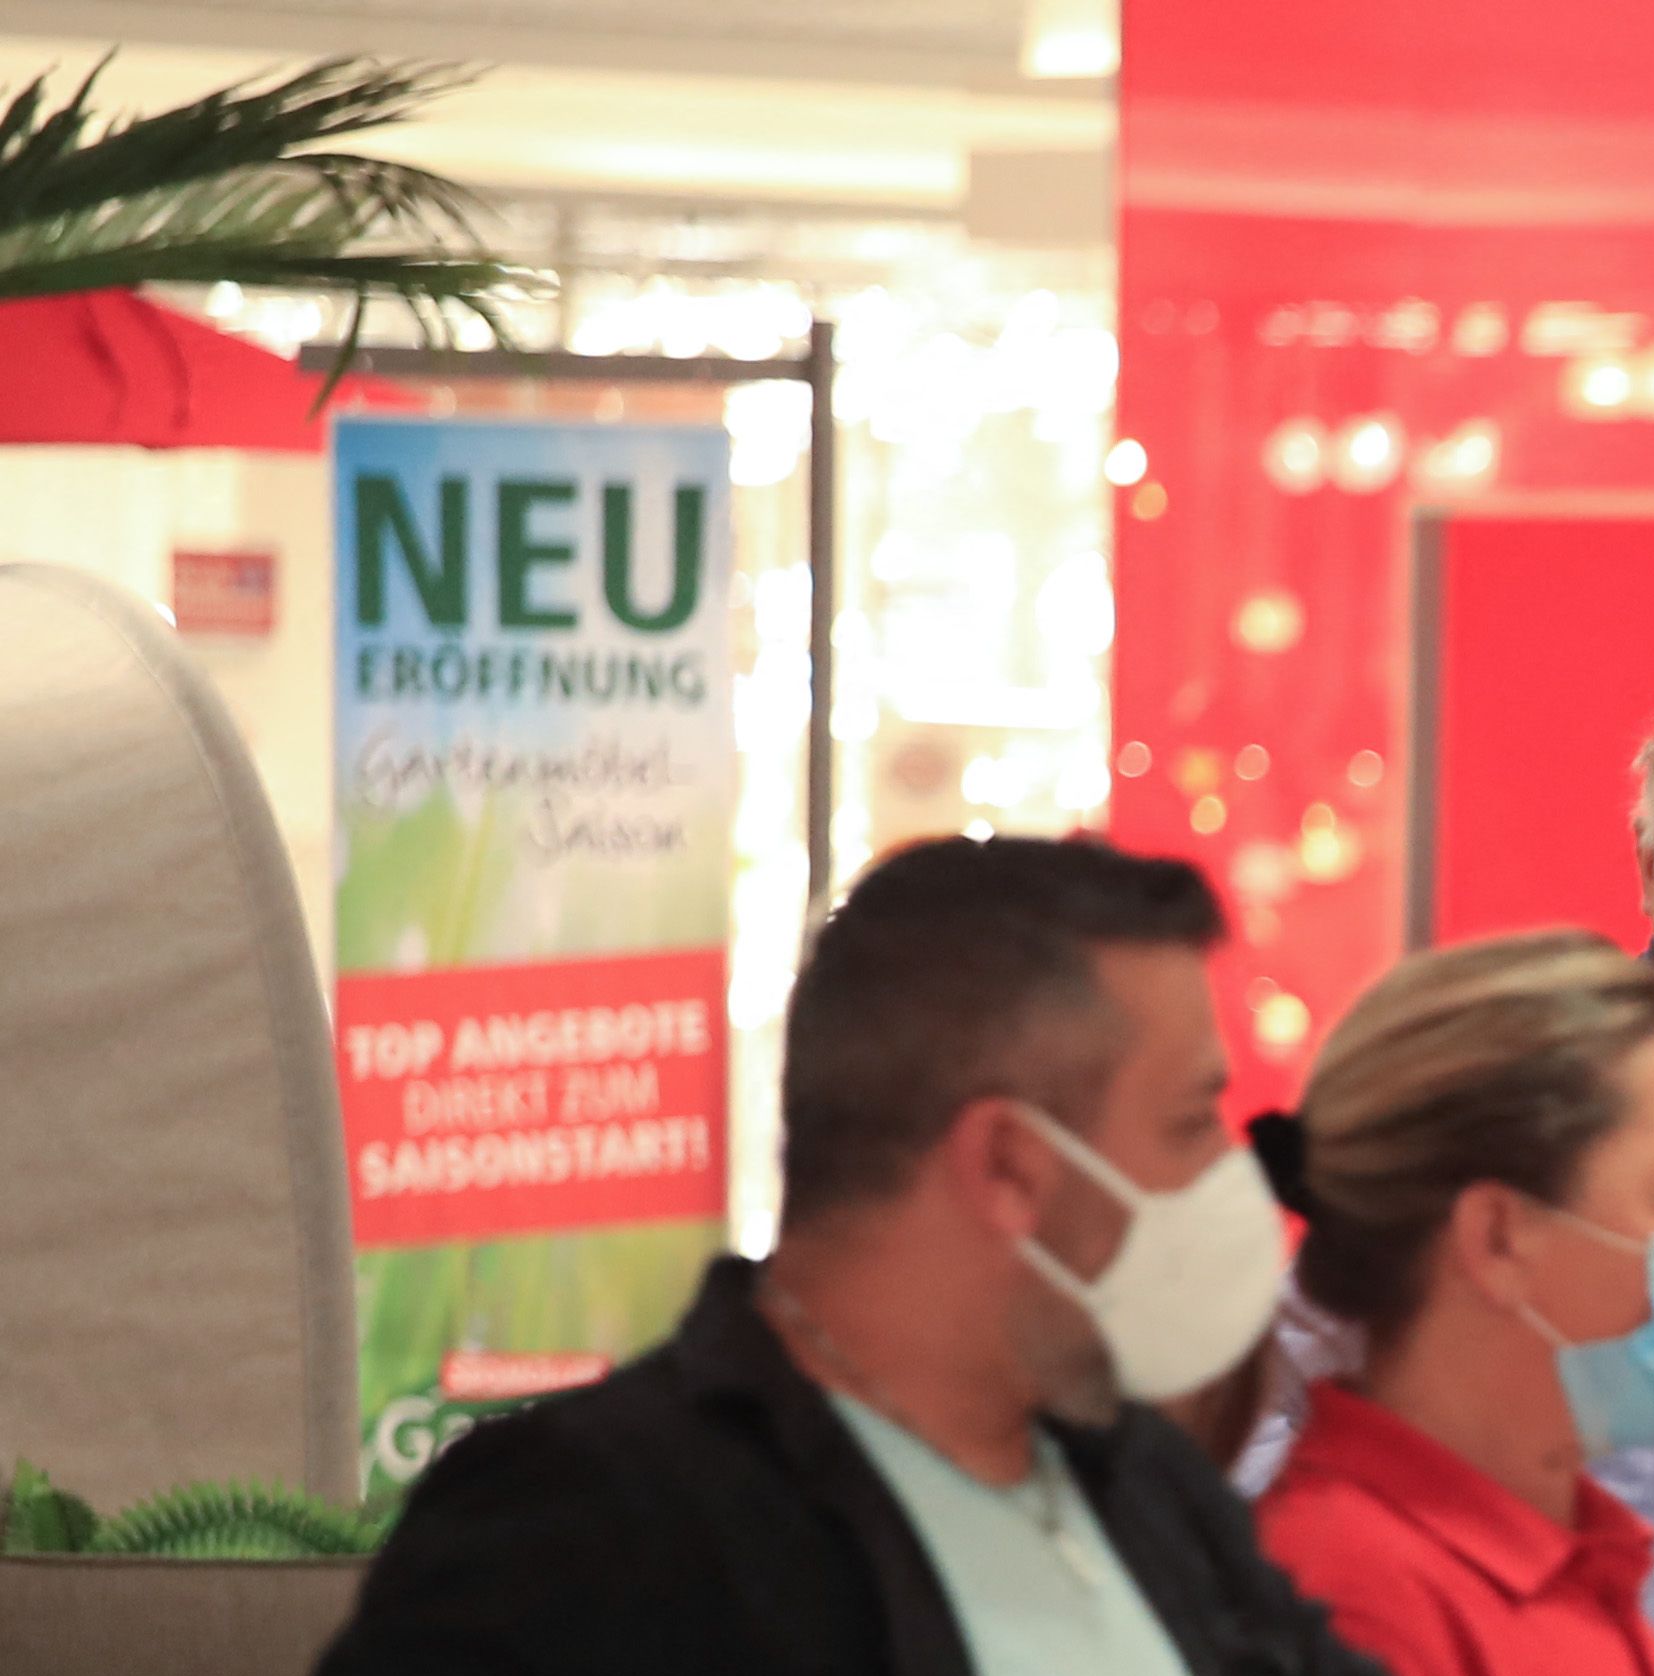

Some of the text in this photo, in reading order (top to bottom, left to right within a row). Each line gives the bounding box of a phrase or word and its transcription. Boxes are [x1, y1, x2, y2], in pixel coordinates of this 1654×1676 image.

[355, 473, 706, 634] NEU
[356, 638, 706, 703] ERÖFFNUNG
[347, 1000, 710, 1081] TOP ANGEBOTE
[404, 1063, 662, 1134] DIREKT ZUM
[358, 1113, 709, 1199] SAISONSTART!
